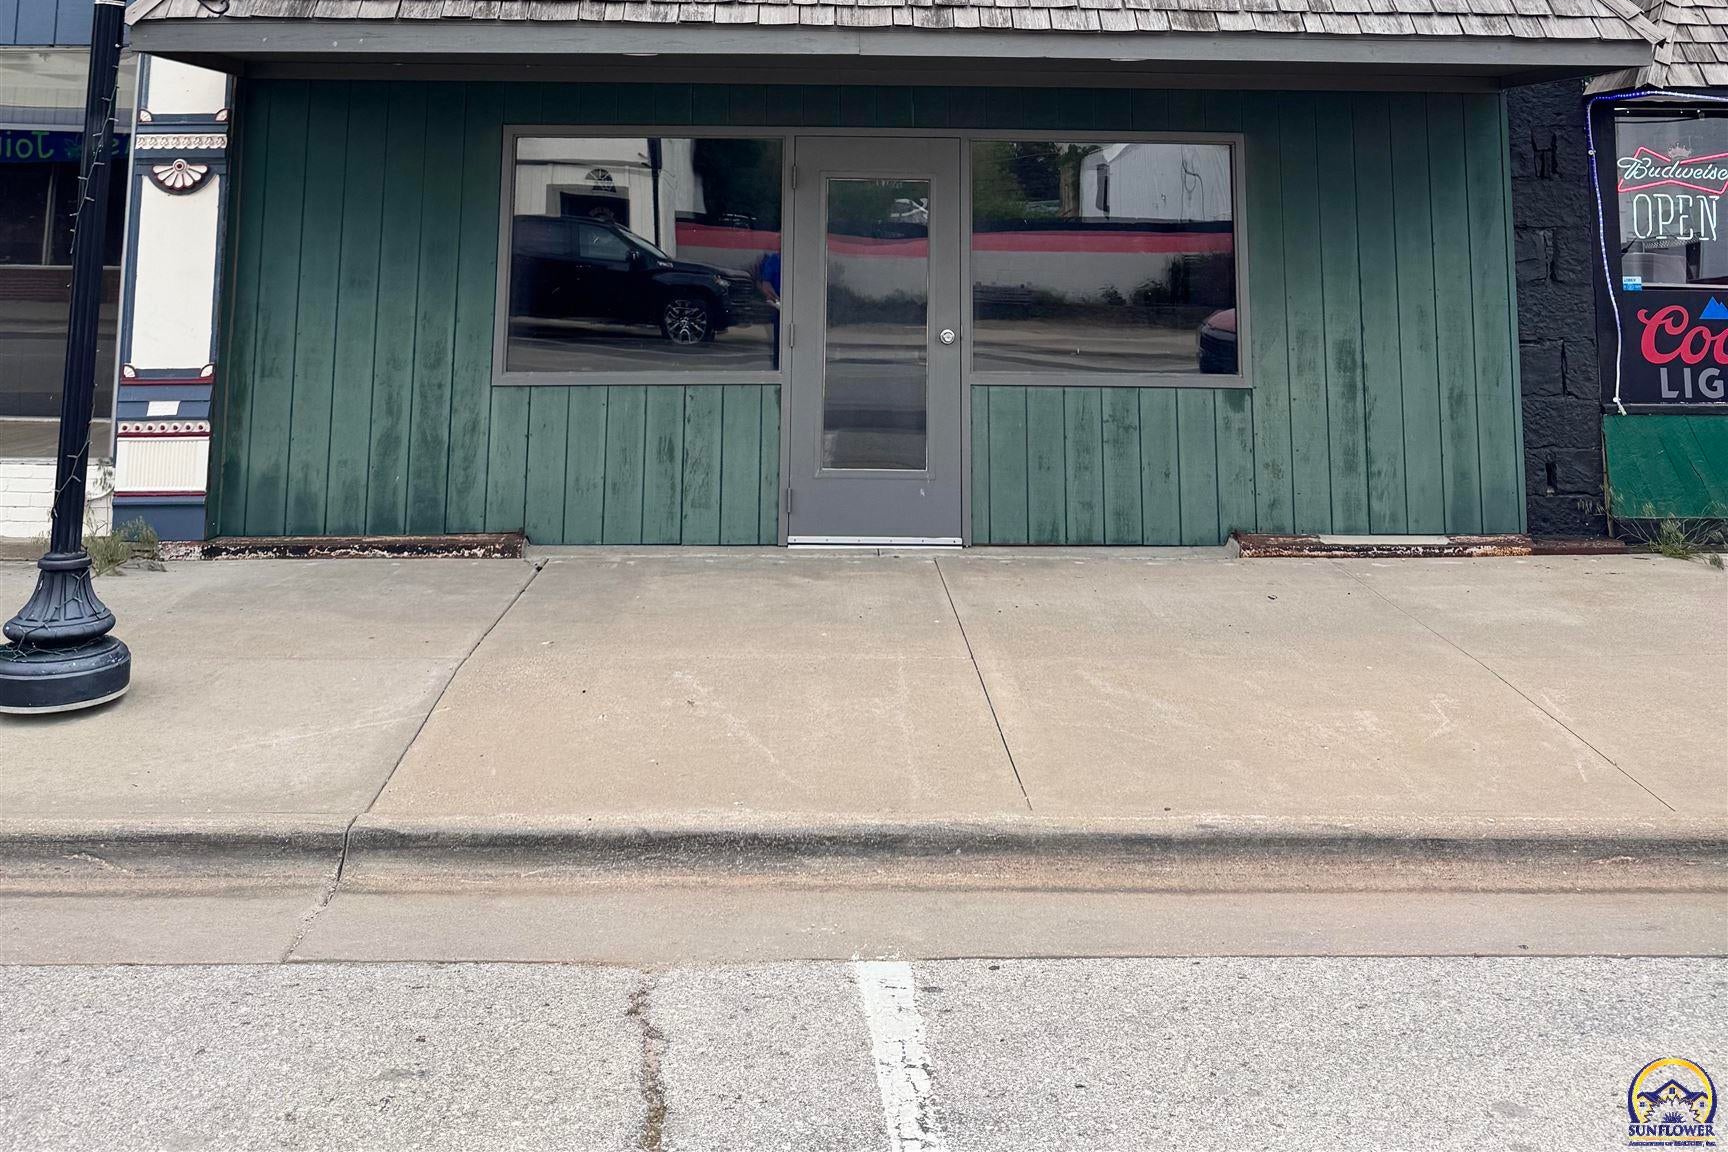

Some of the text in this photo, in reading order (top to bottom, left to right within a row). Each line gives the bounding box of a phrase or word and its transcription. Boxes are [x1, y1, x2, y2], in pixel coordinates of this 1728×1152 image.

[1617, 157, 1728, 180] Budweise
[1633, 194, 1720, 241] OPEN
[1660, 367, 1725, 399] LIG
